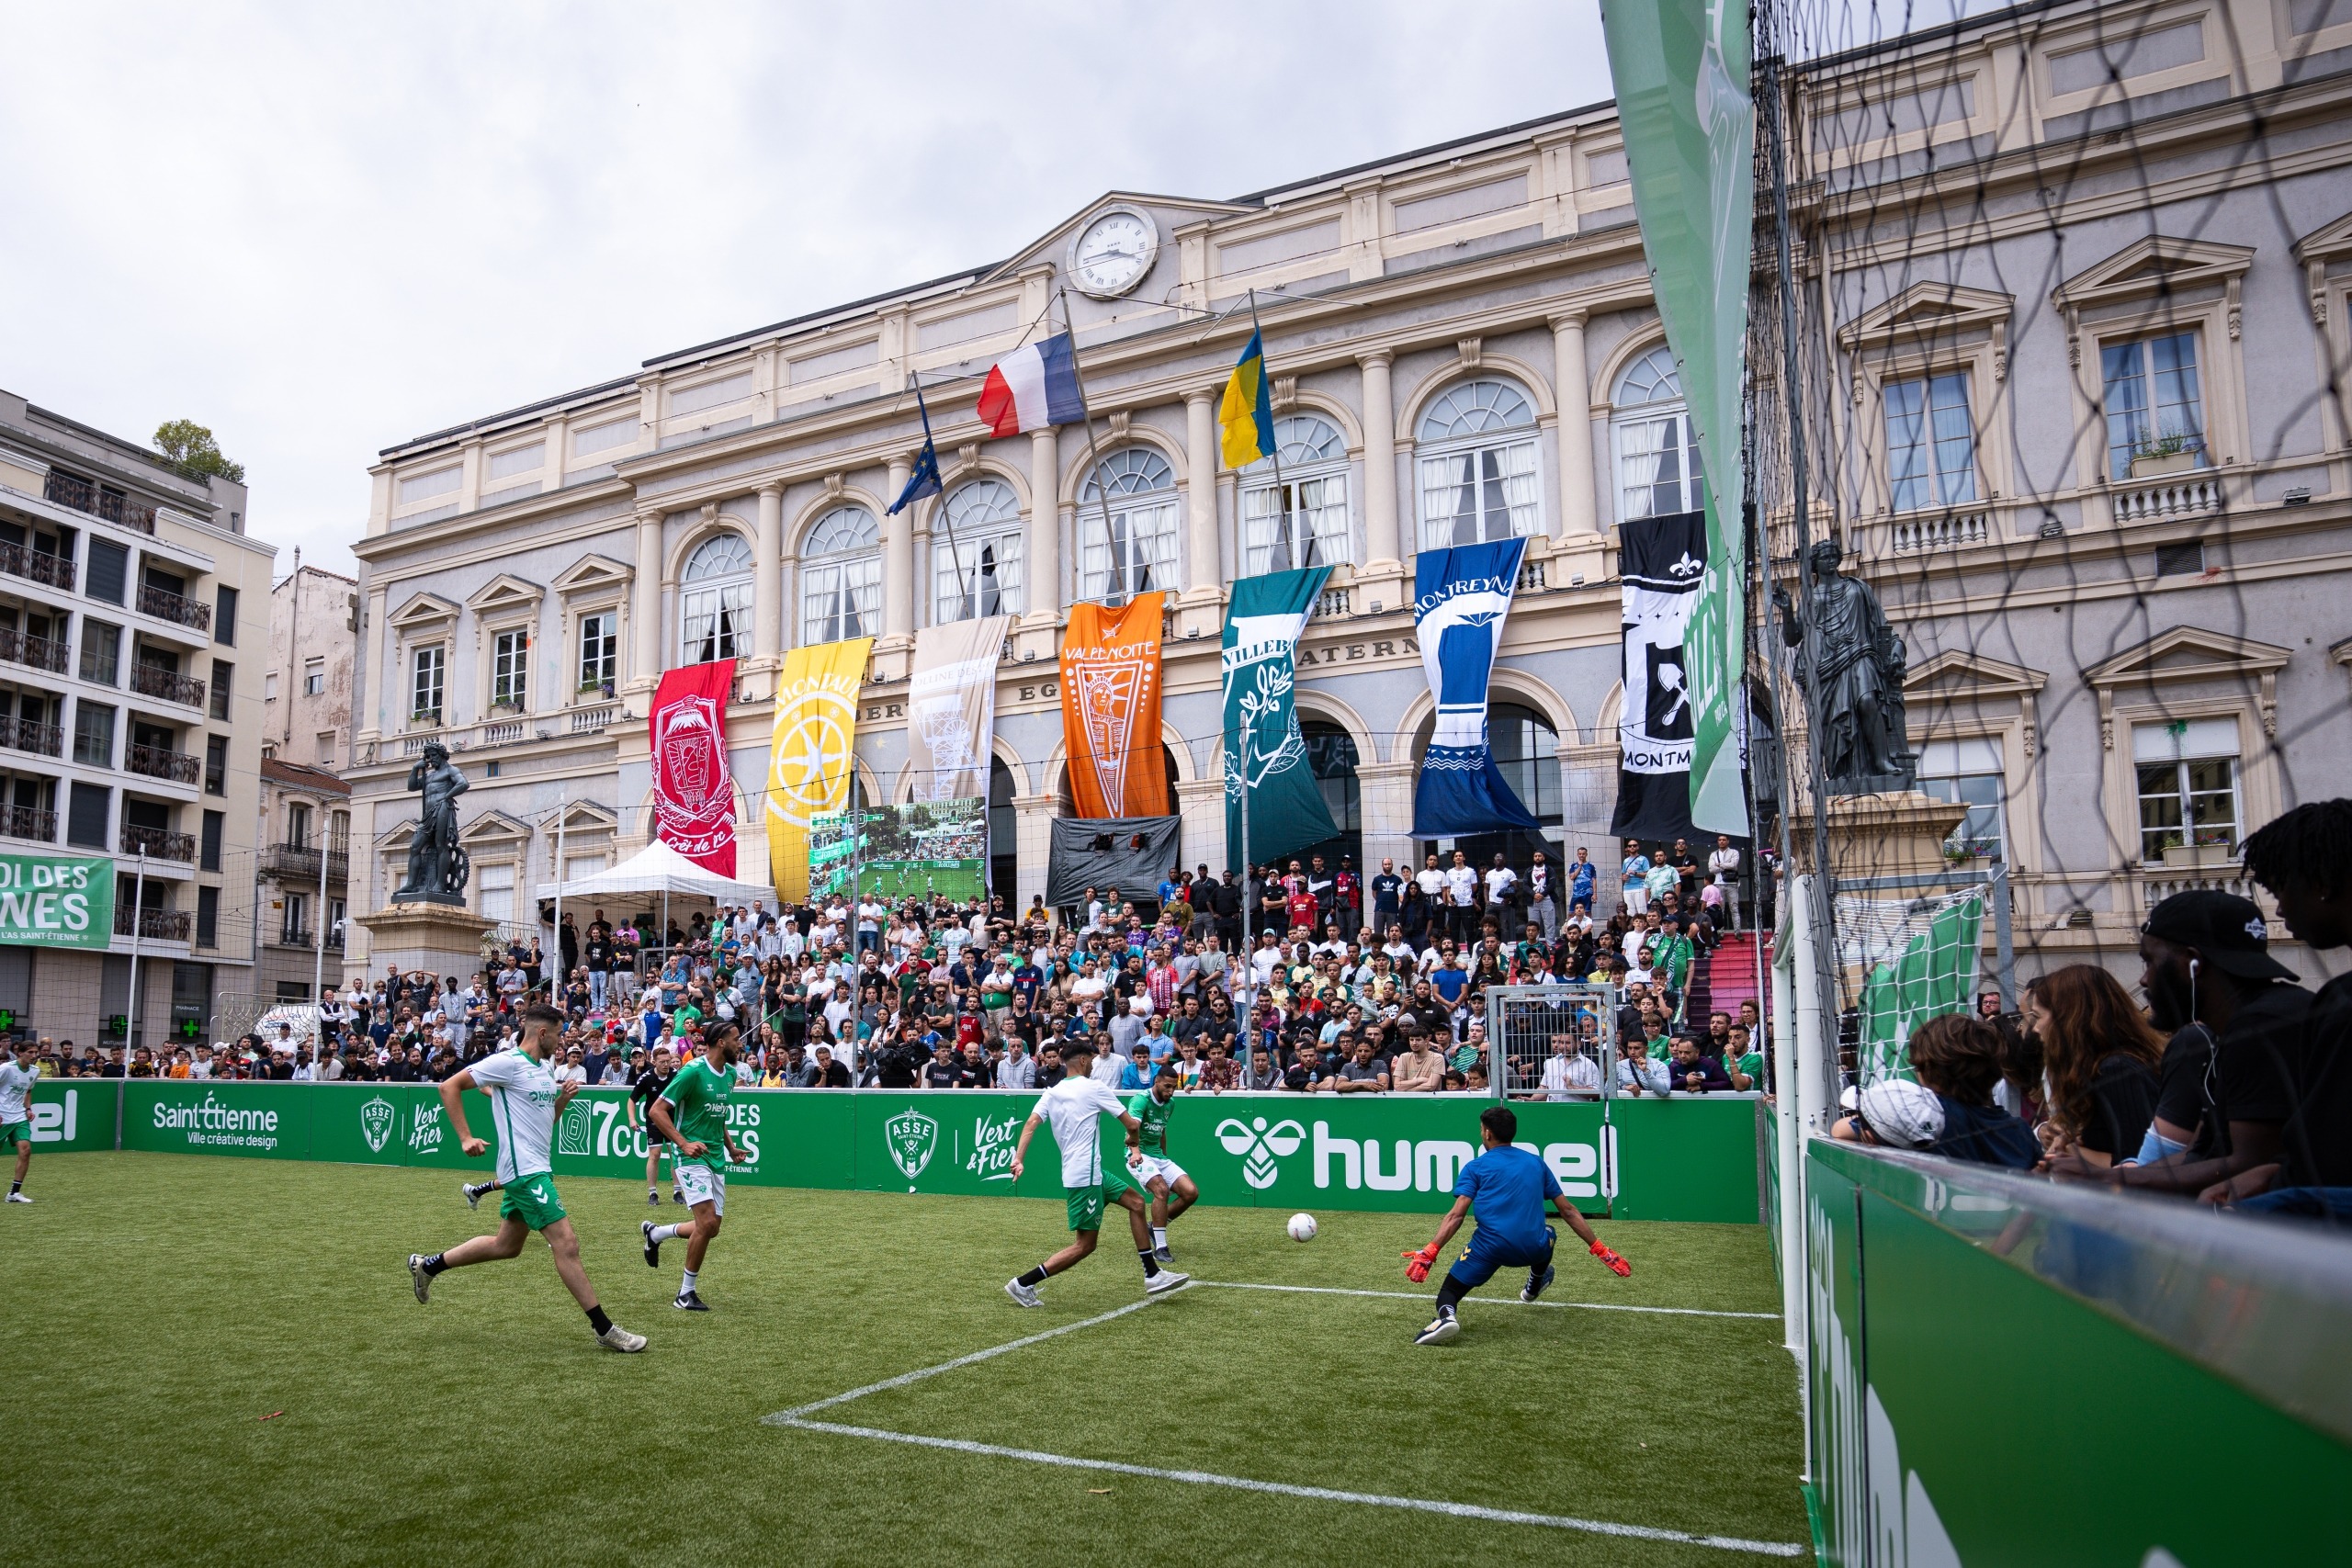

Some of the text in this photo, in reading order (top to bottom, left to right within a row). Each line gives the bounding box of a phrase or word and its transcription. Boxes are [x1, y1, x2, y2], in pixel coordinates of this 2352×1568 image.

[1297, 637, 1420, 666] ATERN
[694, 838, 710, 852] de
[32, 864, 88, 889] DES
[20, 931, 80, 942] SAINT-ÉTIENNE
[366, 1107, 390, 1119] ASSE
[413, 1101, 446, 1128] Vert
[187, 1132, 277, 1150] Ville créative design
[408, 1123, 445, 1150] & Fier
[592, 1100, 620, 1156] 7
[893, 1122, 931, 1137] ASSE
[975, 1113, 1023, 1147] Vert
[966, 1142, 1018, 1176] & Fier
